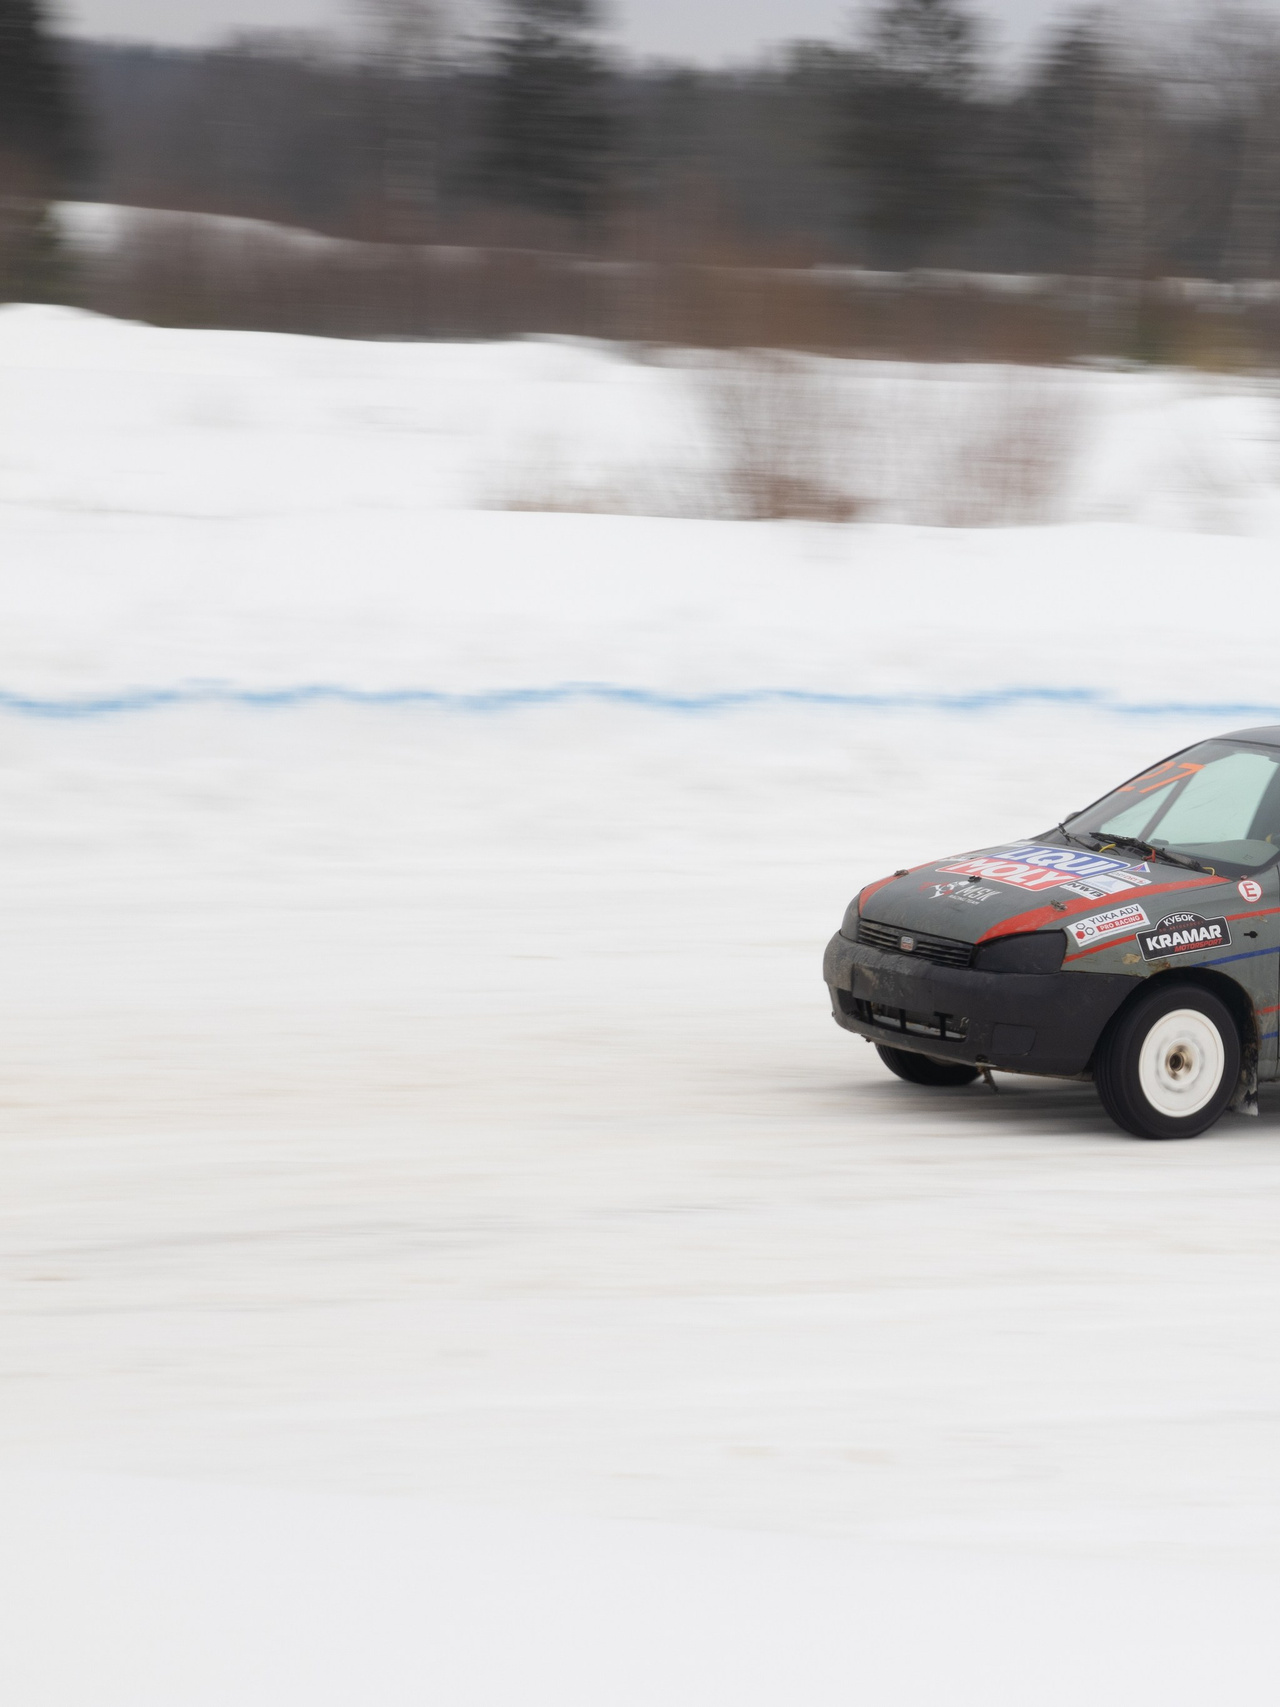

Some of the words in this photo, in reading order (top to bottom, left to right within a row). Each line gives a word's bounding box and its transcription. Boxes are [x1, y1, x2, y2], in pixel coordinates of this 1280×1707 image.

[993, 847, 1120, 875] LIQUI
[950, 859, 1076, 887] MOLY
[957, 884, 1002, 901] MSK
[1243, 883, 1257, 897] E
[1088, 912, 1118, 925] YUKA
[1119, 905, 1140, 917] ADV
[1099, 923, 1115, 931] PRO
[1115, 915, 1141, 928] RACING
[1163, 914, 1195, 926] КУБОК
[1146, 924, 1222, 951] KRAMAR
[1174, 938, 1223, 953] MOTORSPORT
